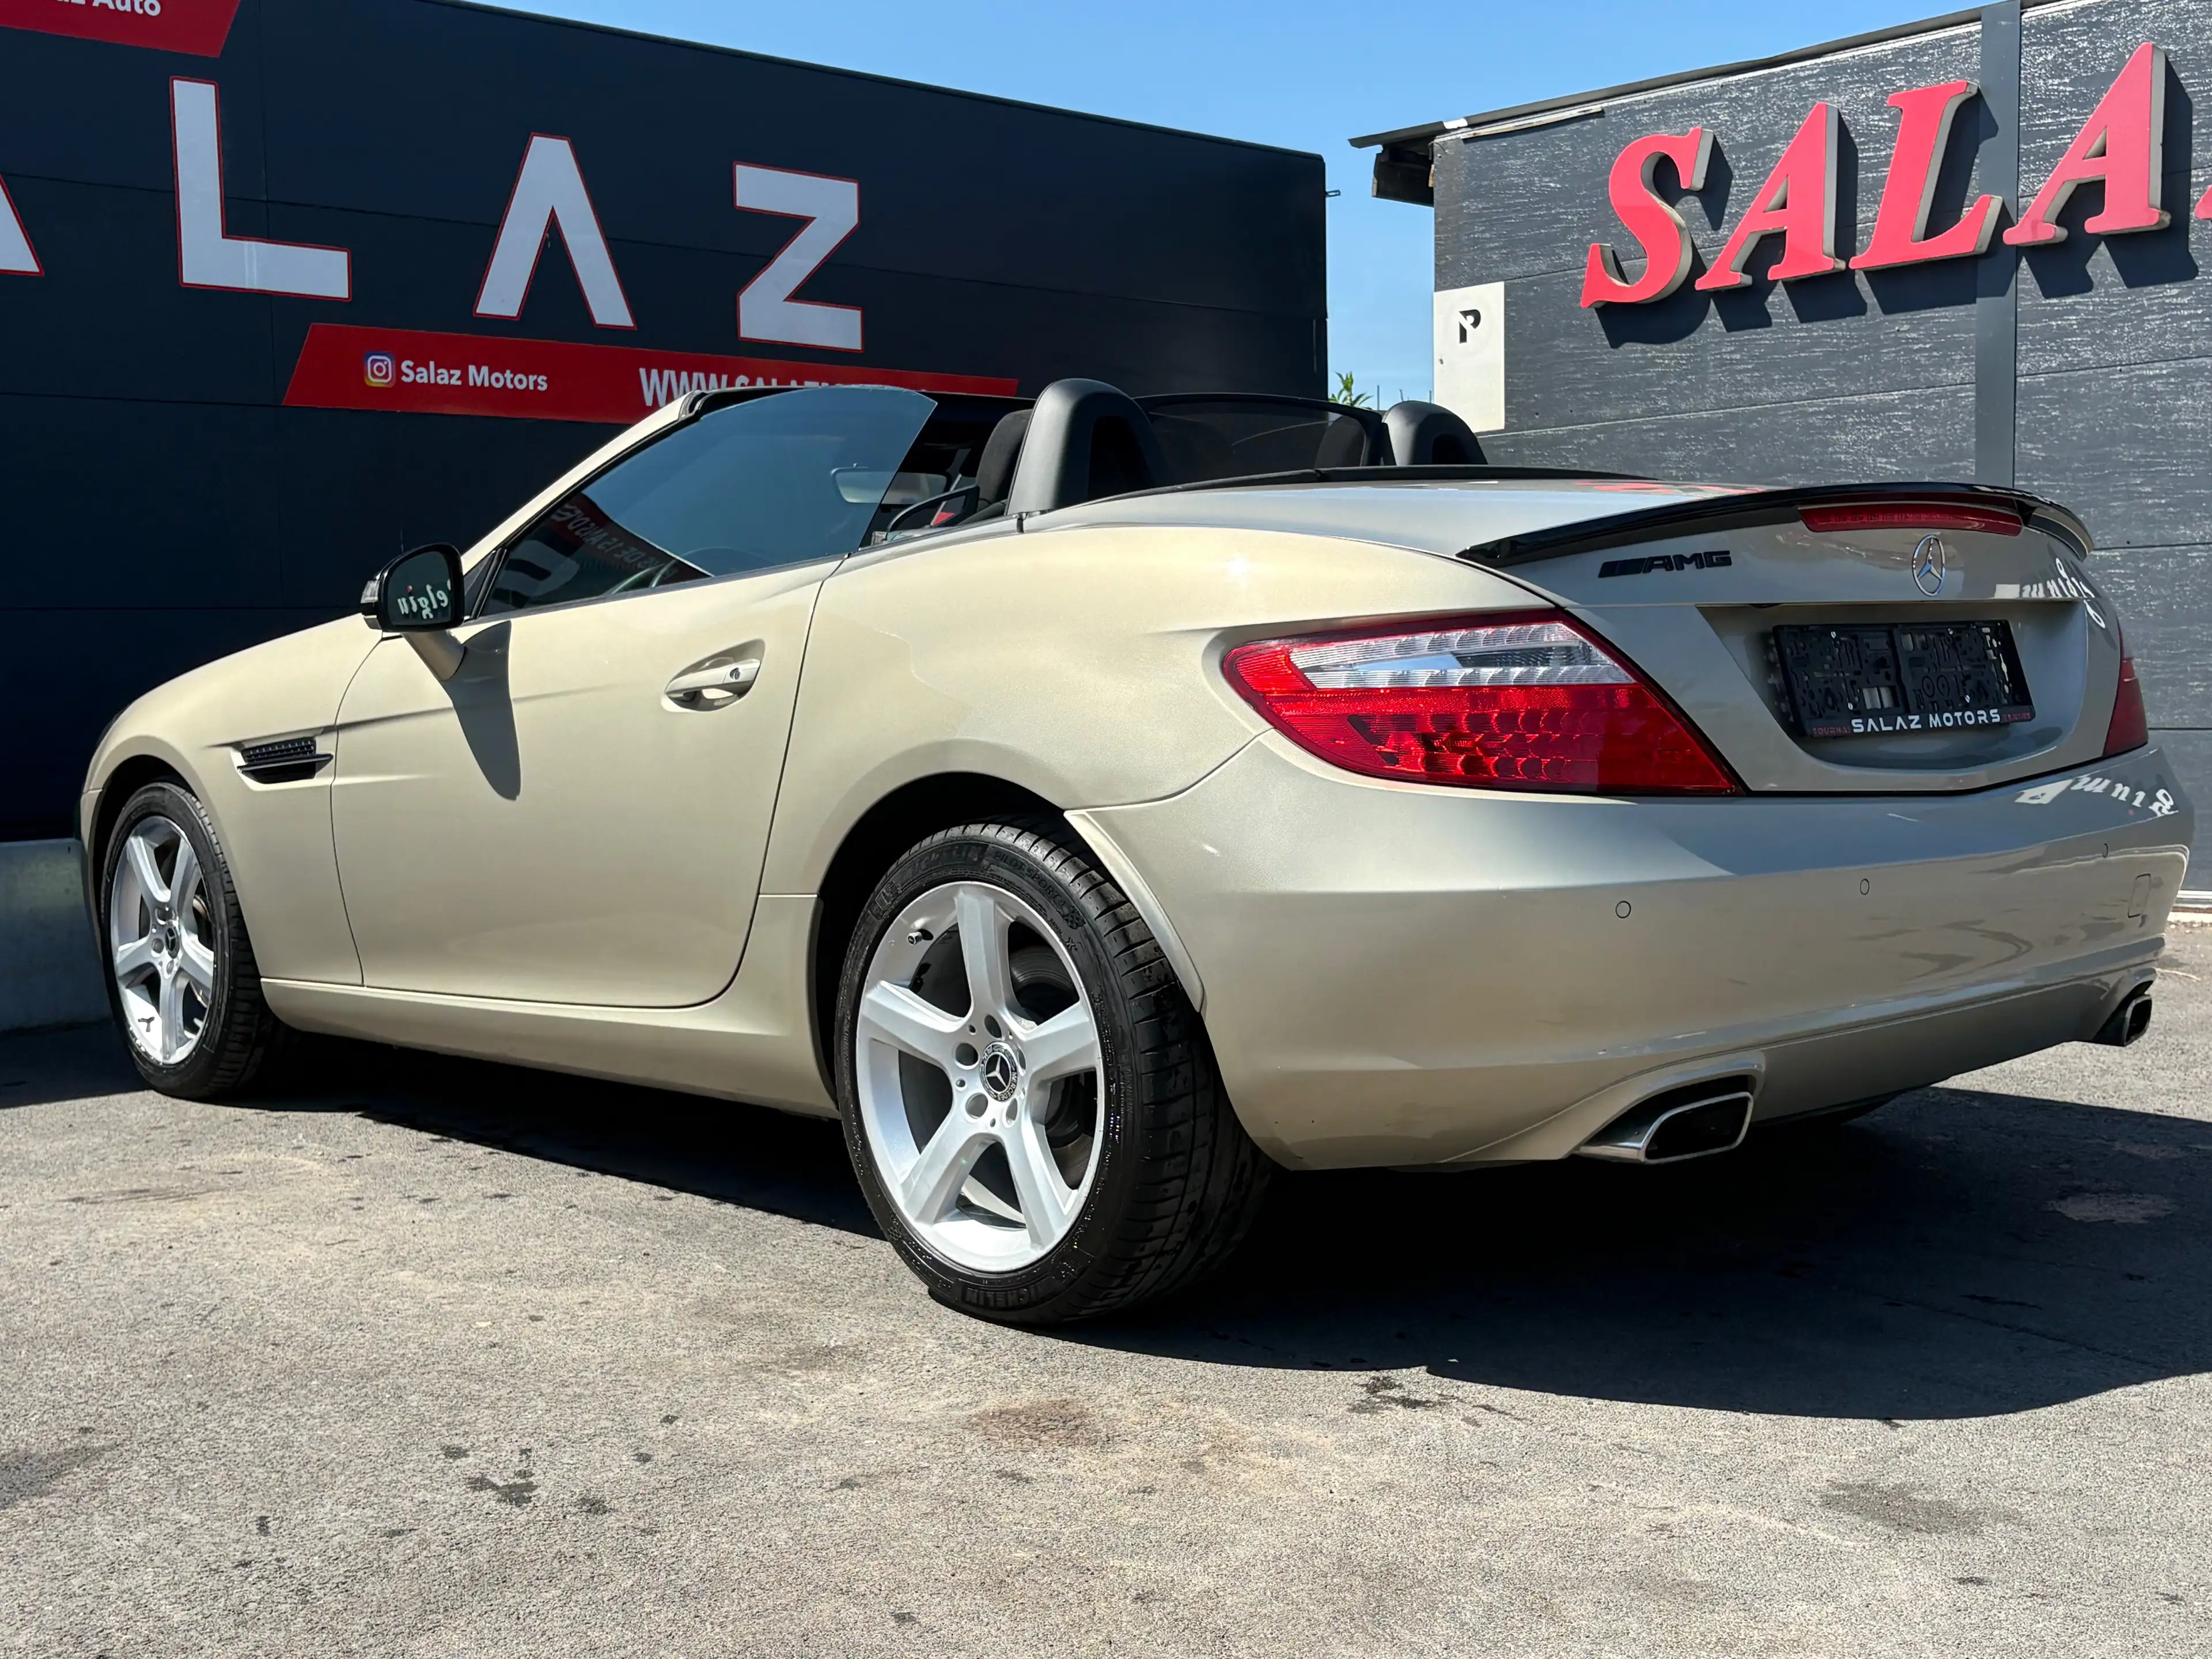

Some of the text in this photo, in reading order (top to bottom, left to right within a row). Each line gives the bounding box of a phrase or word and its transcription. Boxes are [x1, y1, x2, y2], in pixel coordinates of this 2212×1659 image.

[1581, 41, 2212, 308] SALA
[0, 75, 863, 352] LAZ
[401, 360, 547, 391] Salaz Motors
[1851, 714, 1922, 733] SALAZ
[1928, 709, 2001, 728] MOTORS
[997, 1071, 1018, 1101] MERCEDES
